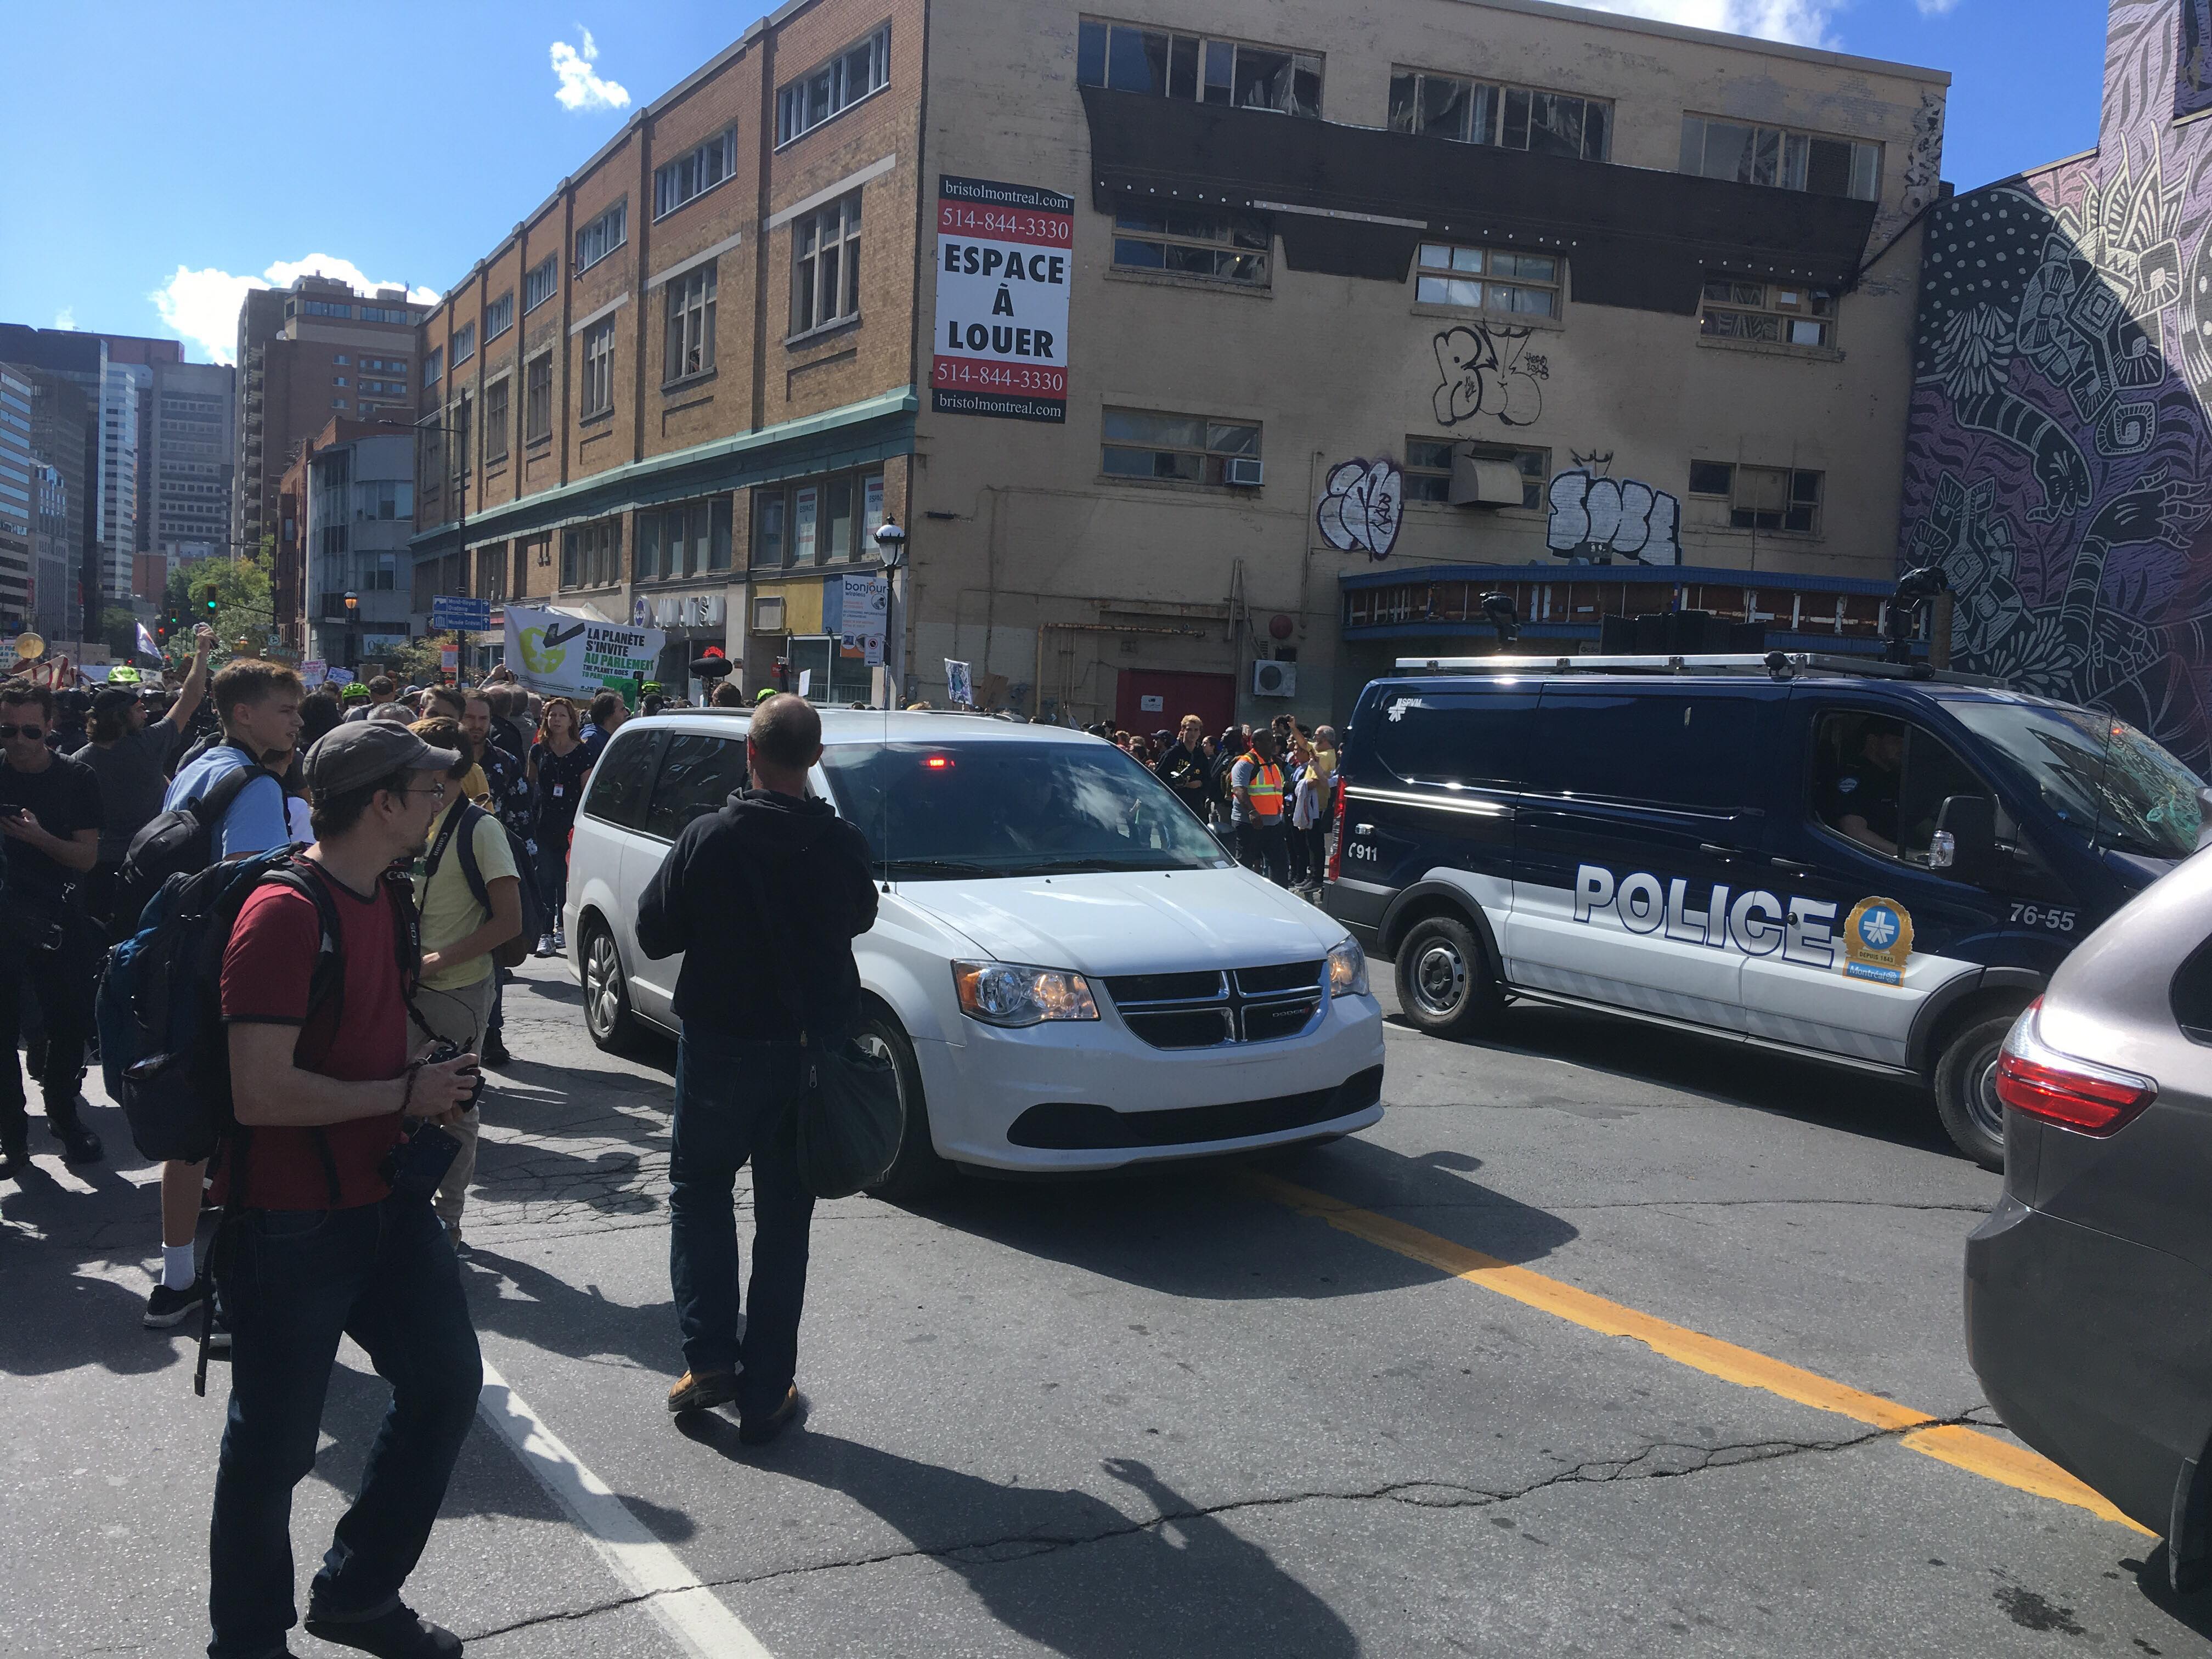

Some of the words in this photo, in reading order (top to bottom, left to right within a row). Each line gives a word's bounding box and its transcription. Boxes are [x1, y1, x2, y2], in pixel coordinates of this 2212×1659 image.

[945, 180, 1069, 208] bristolmontreal.com
[943, 207, 1069, 240] 514-844-3330
[945, 243, 1064, 285] ESPACE
[992, 283, 1014, 317] À
[949, 320, 1054, 359] LOUER
[938, 363, 1063, 391] 514-844-3330
[939, 393, 1061, 417] bristolmontreal.com
[845, 580, 887, 594] bonjour
[586, 640, 629, 657] S'INVITE
[587, 628, 600, 640] LA
[602, 629, 645, 647] PLANÈTE
[584, 652, 599, 665] AU
[600, 654, 654, 671] PARLEMENT
[594, 665, 613, 675] PLANET
[1401, 698, 1423, 707] SPVM
[434, 832, 448, 855] Canon
[1356, 844, 1378, 861] 911
[1573, 862, 1839, 969] POLICE
[2010, 902, 2075, 931] 76-55
[1859, 951, 1878, 961] DEPUIS
[1849, 965, 1885, 980] Montréal
